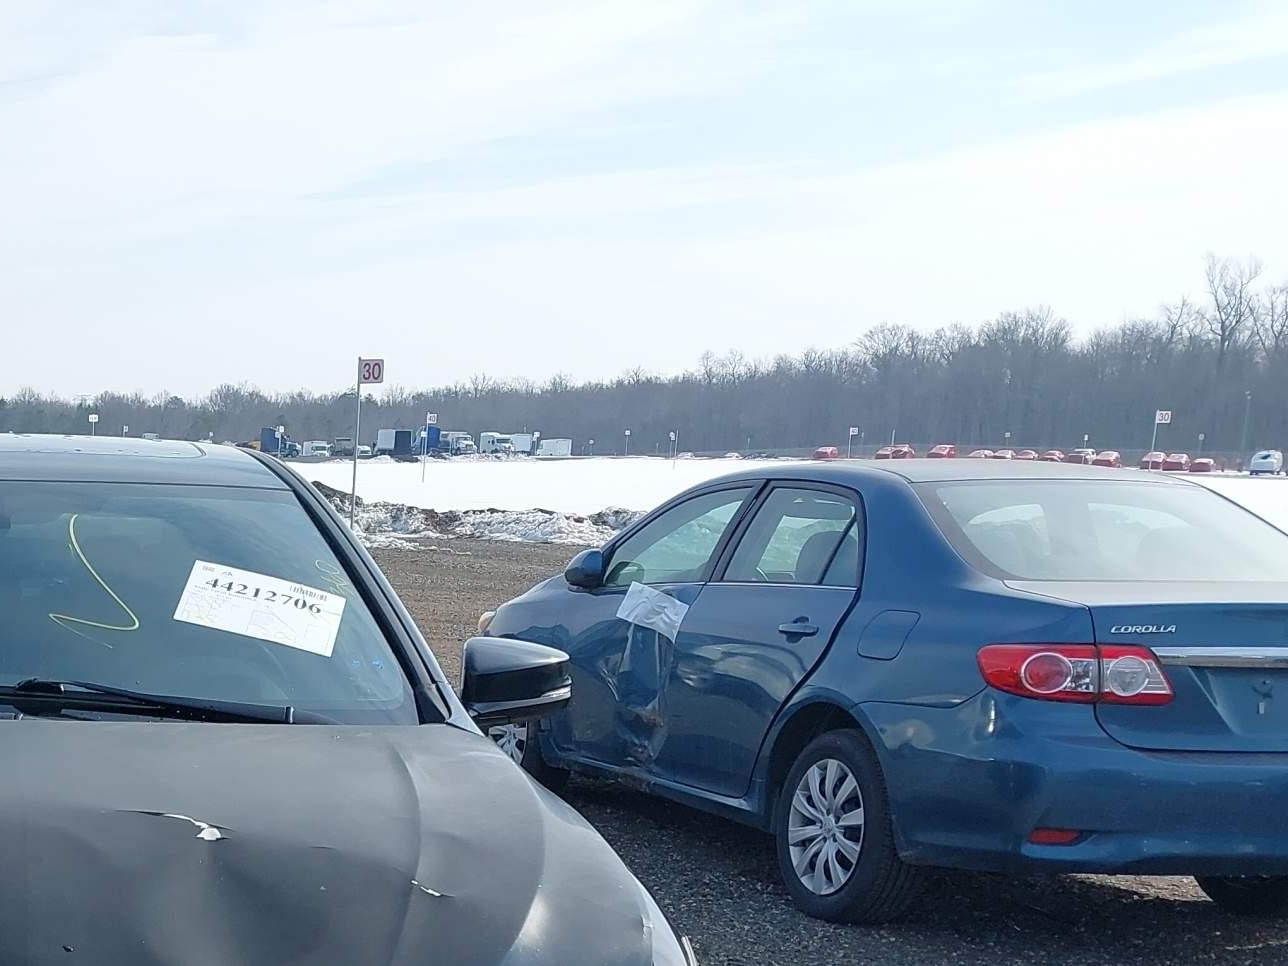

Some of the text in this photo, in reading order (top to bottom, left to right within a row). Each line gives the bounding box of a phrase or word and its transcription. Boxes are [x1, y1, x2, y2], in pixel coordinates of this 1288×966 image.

[363, 362, 381, 380] 30
[1159, 412, 1169, 421] 30
[205, 578, 322, 614] 44212706
[1111, 624, 1176, 633] COROLLA
